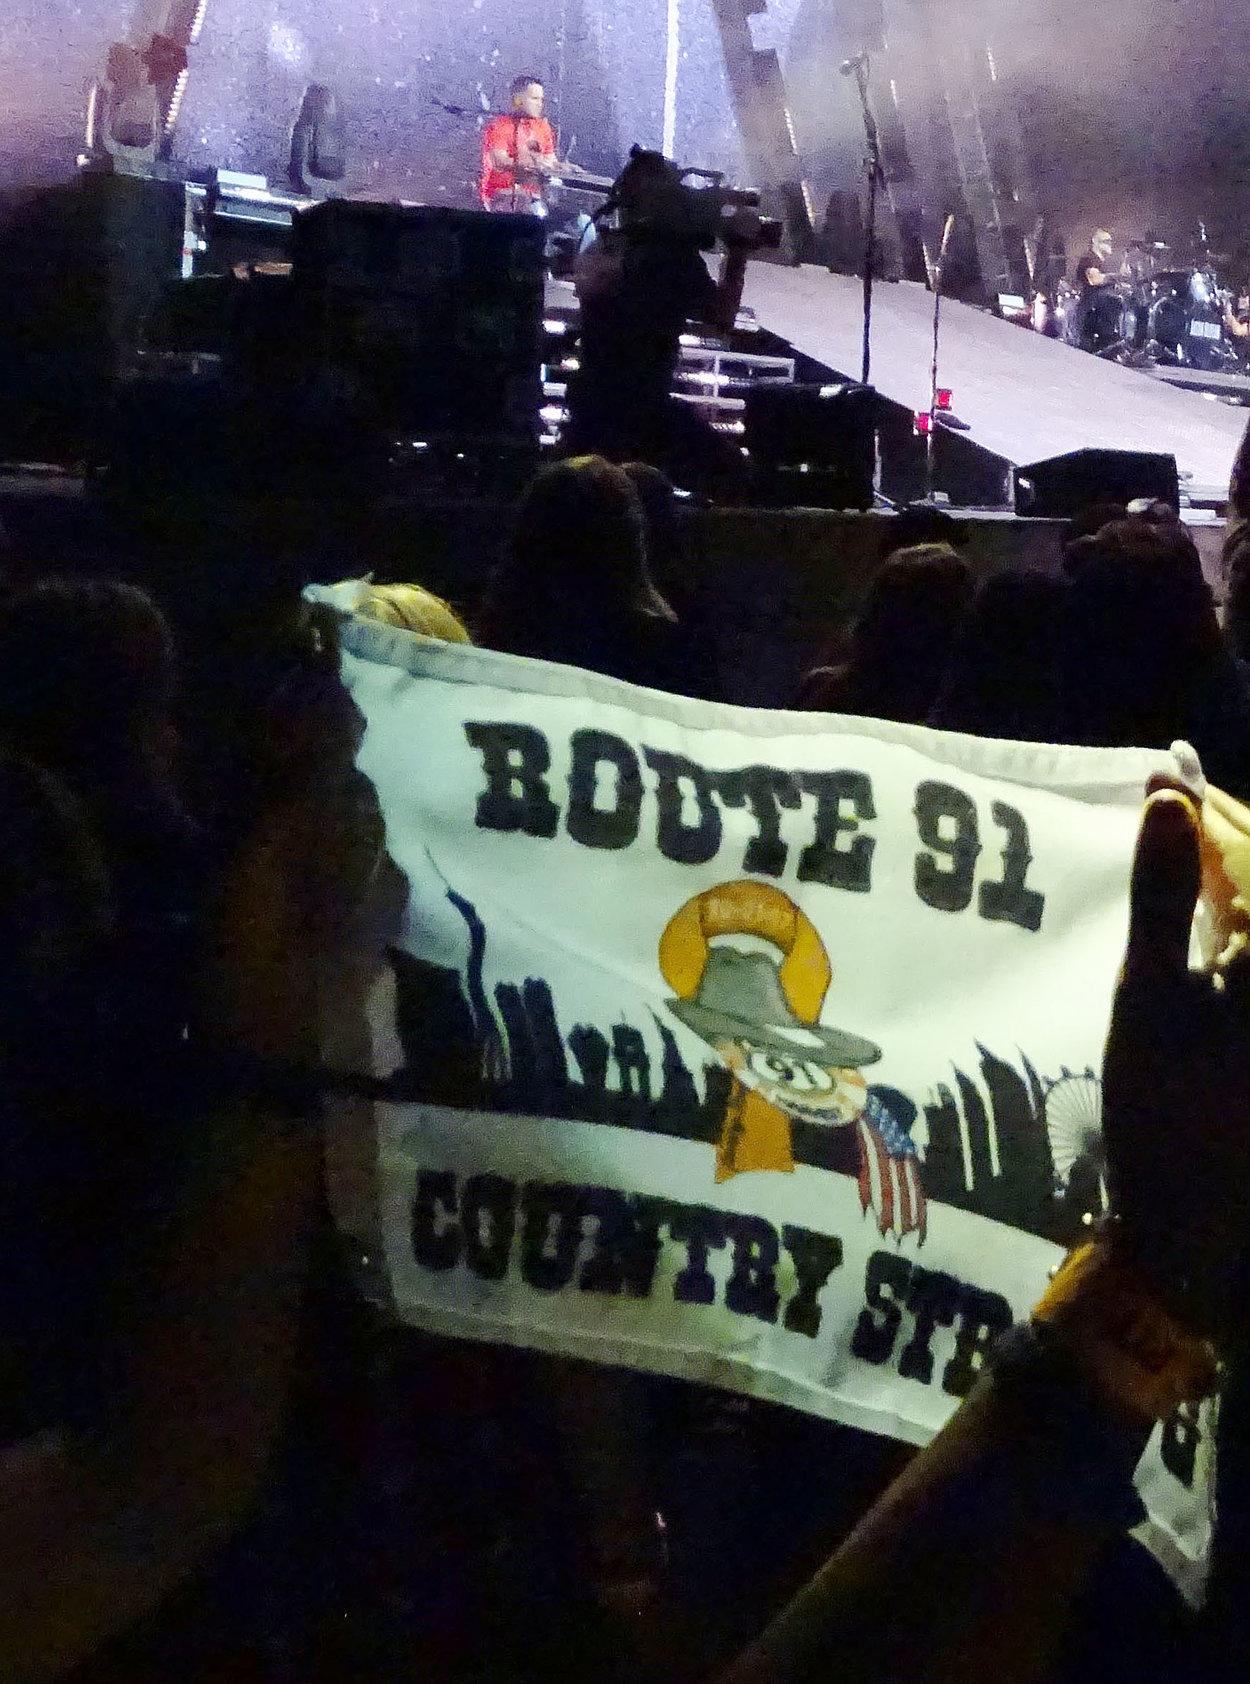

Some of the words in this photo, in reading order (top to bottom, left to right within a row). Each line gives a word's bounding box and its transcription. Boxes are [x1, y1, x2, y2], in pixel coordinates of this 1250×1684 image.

[463, 720, 877, 894] ROUTE
[912, 780, 1045, 932] 91
[410, 1168, 844, 1338] COUNTRY
[850, 1250, 1013, 1397] STR
